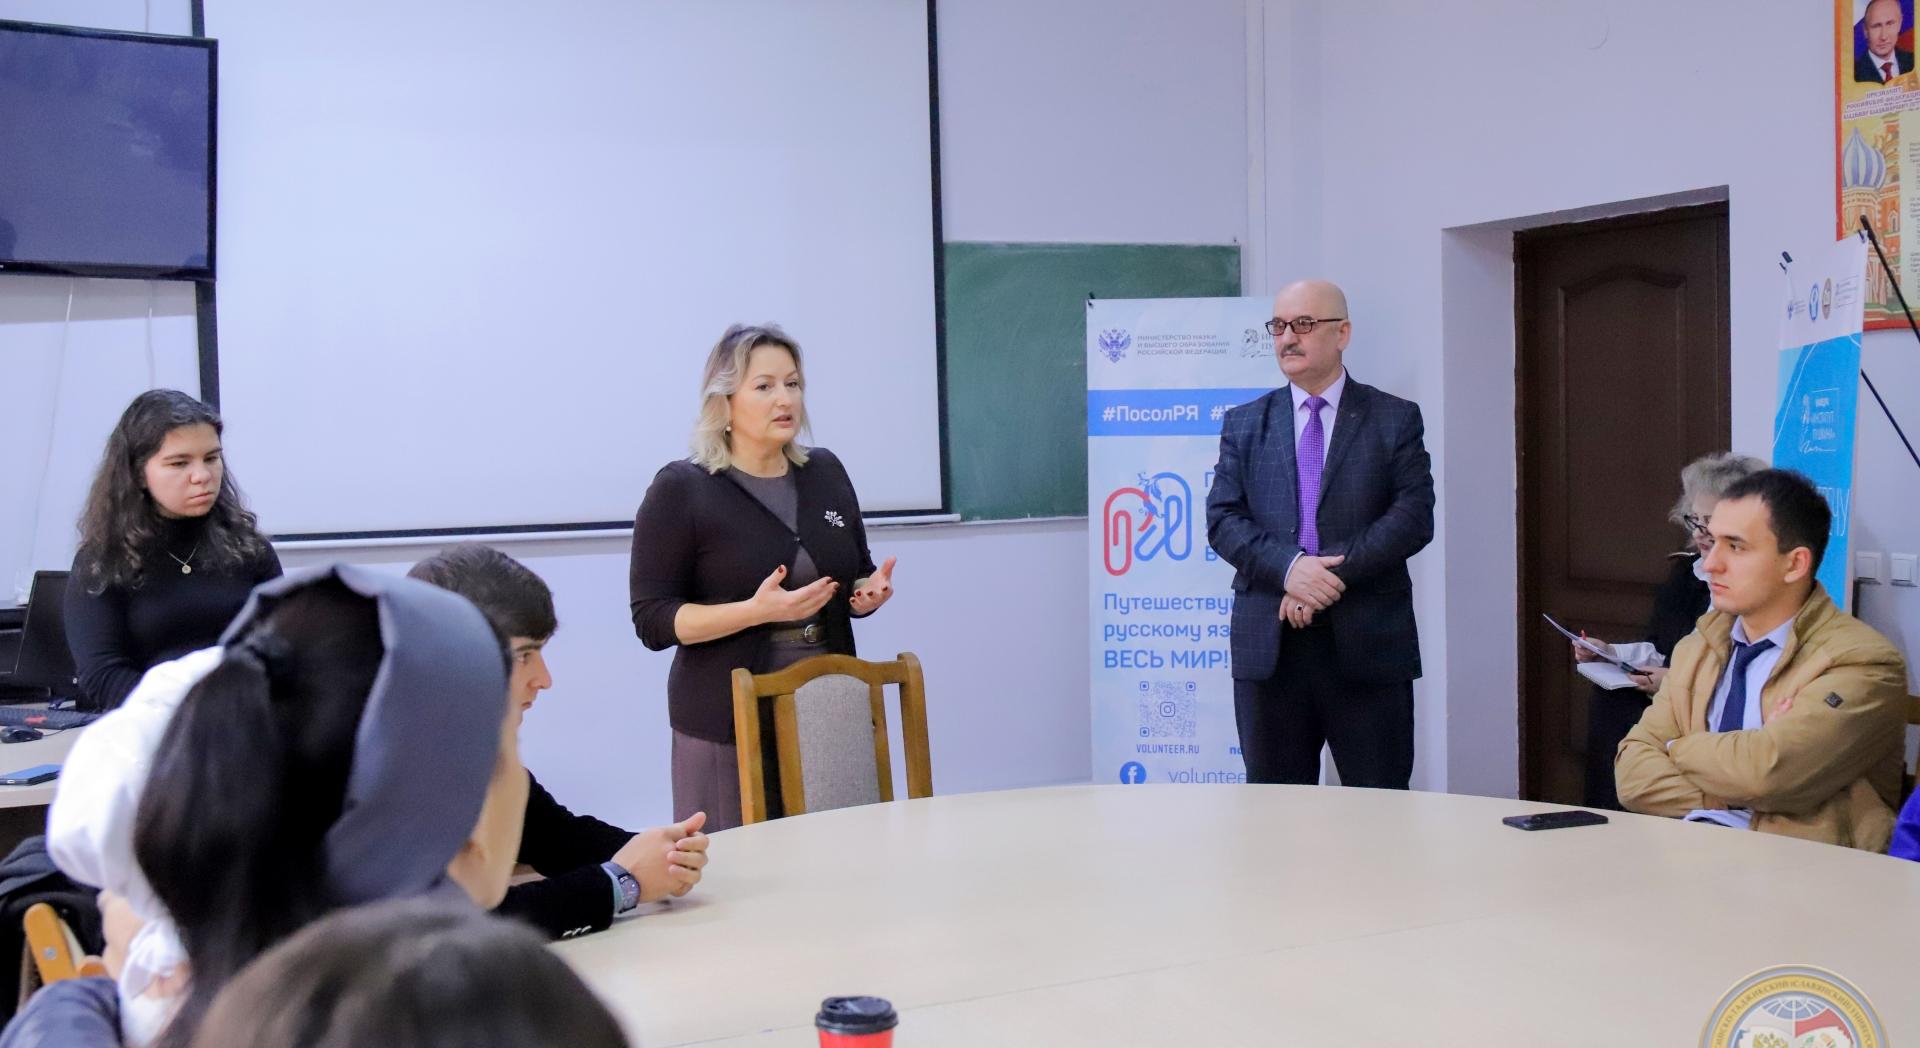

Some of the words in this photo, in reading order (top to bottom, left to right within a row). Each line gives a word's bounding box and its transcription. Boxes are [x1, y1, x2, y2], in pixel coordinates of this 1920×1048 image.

[1102, 405, 1199, 422] #ПосолРЯ
[1104, 623, 1201, 642] русскому
[1207, 624, 1232, 638] яз
[1104, 649, 1165, 669] ВЕСЬ
[1170, 649, 1229, 669] МИР!
[1136, 743, 1200, 755] VOLUNTEER.RU
